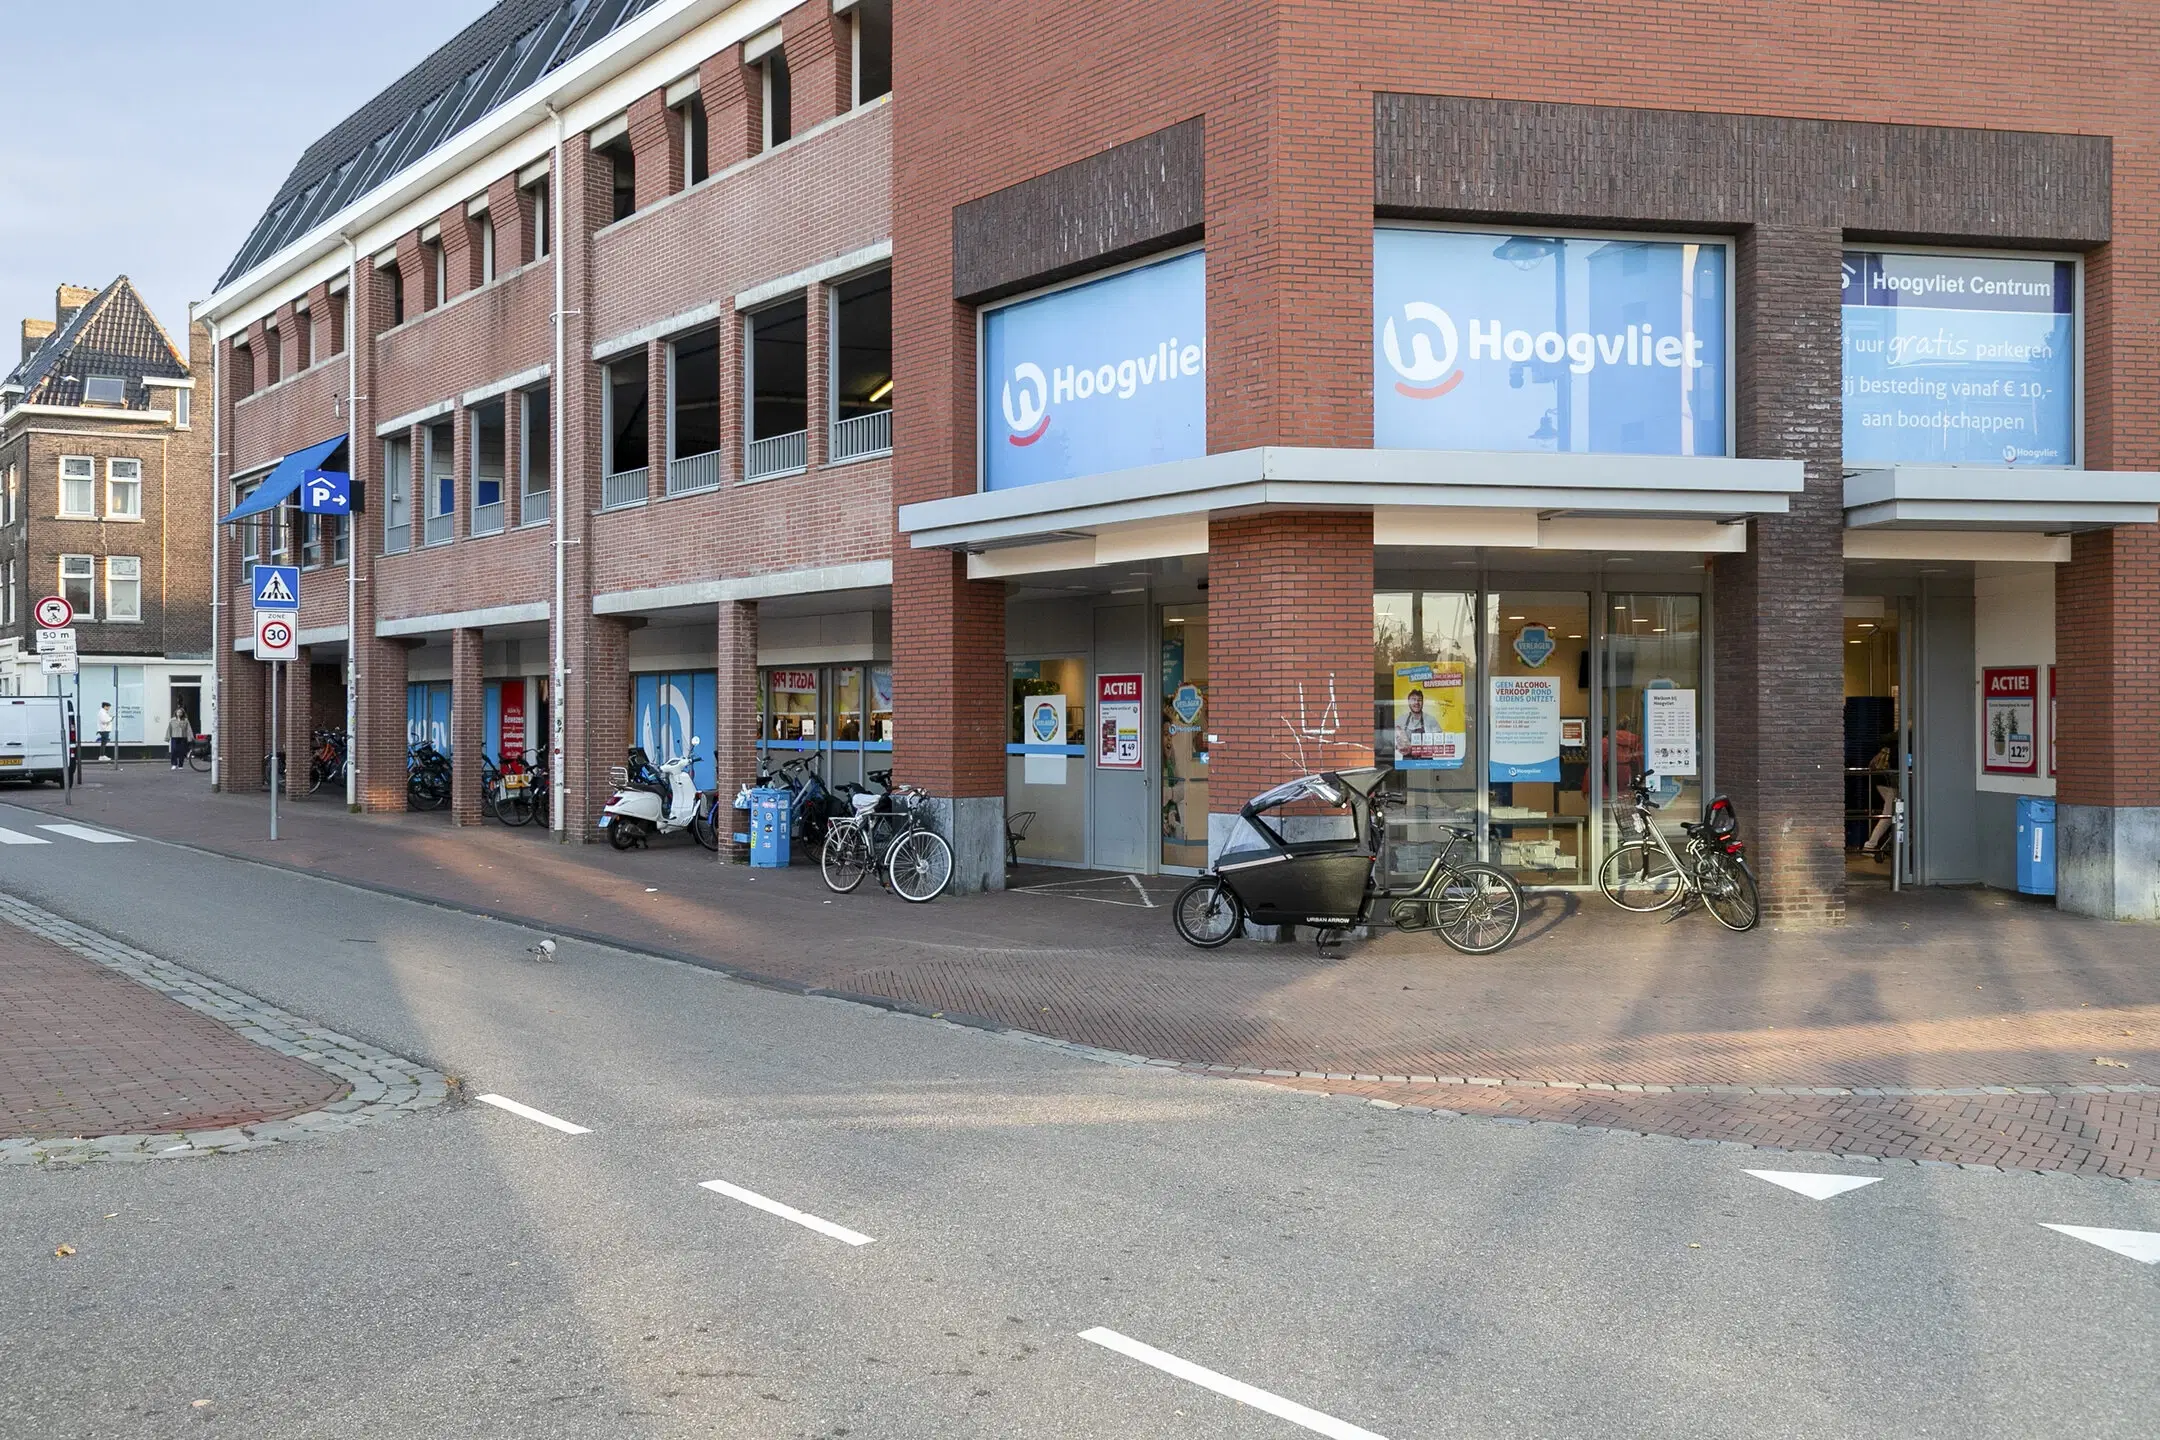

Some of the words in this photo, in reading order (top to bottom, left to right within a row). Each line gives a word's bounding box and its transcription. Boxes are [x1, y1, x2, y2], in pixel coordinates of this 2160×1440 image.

[1873, 271, 1965, 296] Hoogvliet
[1970, 276, 2051, 297] Centrum
[1469, 318, 1704, 375] Hoogvliet
[1856, 339, 1885, 353] uur
[1886, 327, 1969, 365] gratis
[1976, 340, 2053, 361] parkeren
[1841, 376, 1854, 397] ij
[1860, 376, 1947, 400] besteding
[1951, 380, 2000, 397] vanaf
[2003, 380, 2016, 397] €
[2020, 382, 2053, 400] 10,-
[1861, 412, 1893, 427] aan
[1898, 409, 2025, 433] boodschappen
[2017, 447, 2059, 459] Hoogvliet
[312, 487, 331, 507] P
[42, 631, 57, 640] 50
[266, 629, 287, 641] 30
[1103, 682, 1137, 696] ACTIE!
[1515, 681, 1551, 689] ALCOHOL-
[1991, 675, 2030, 691] ACTIE!
[1495, 688, 1530, 696] VERKOOP
[1531, 688, 1552, 696] ROND
[1495, 695, 1525, 703] LEIDENS
[1526, 695, 1557, 703] ONTZET.
